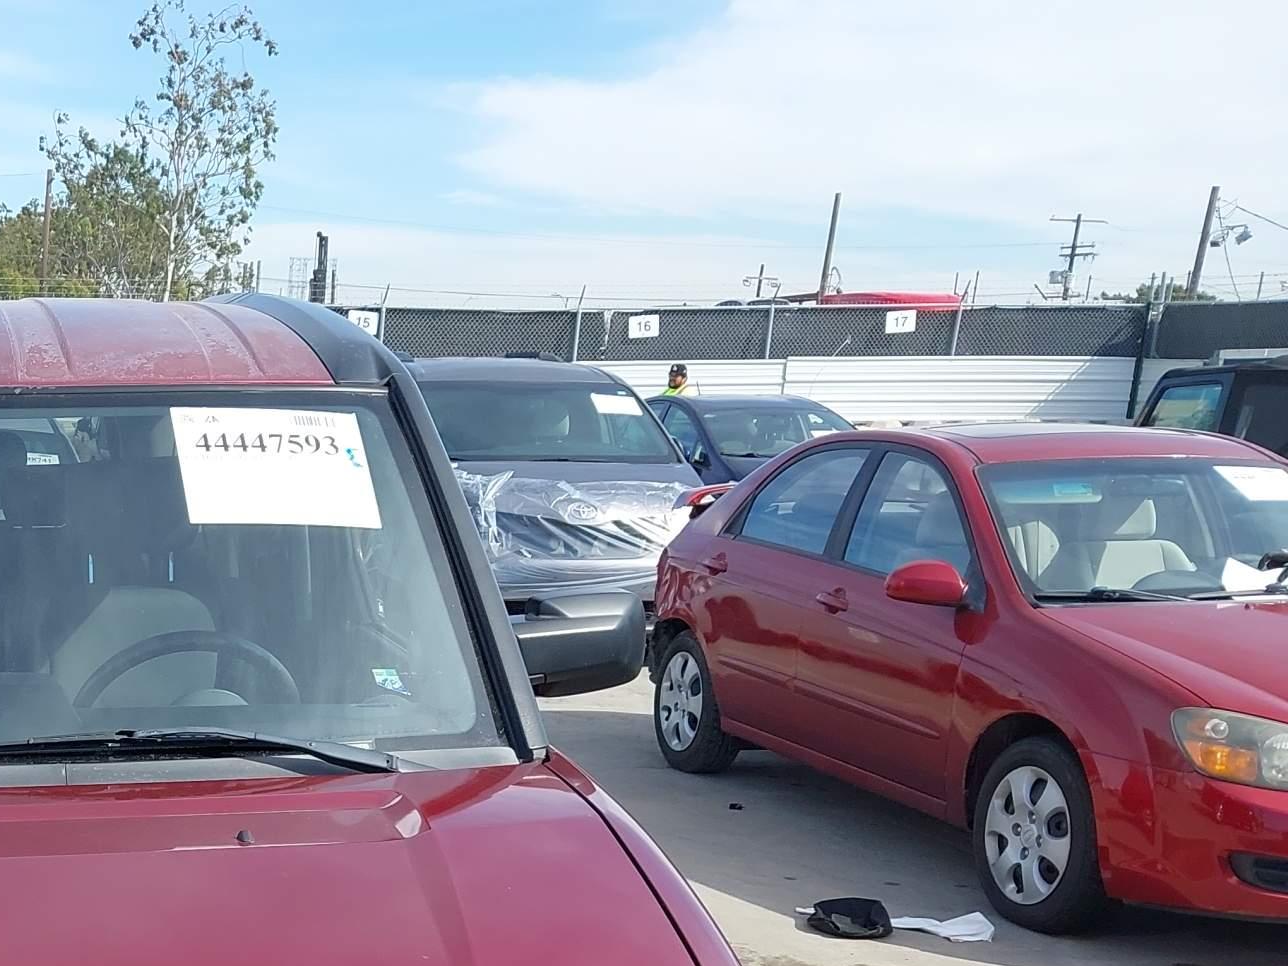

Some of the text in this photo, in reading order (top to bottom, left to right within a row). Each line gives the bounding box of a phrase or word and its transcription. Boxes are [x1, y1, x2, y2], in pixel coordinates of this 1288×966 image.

[356, 316, 370, 328] 15
[637, 320, 652, 332] 16
[894, 316, 909, 327] 17
[195, 432, 339, 456] 44447593
